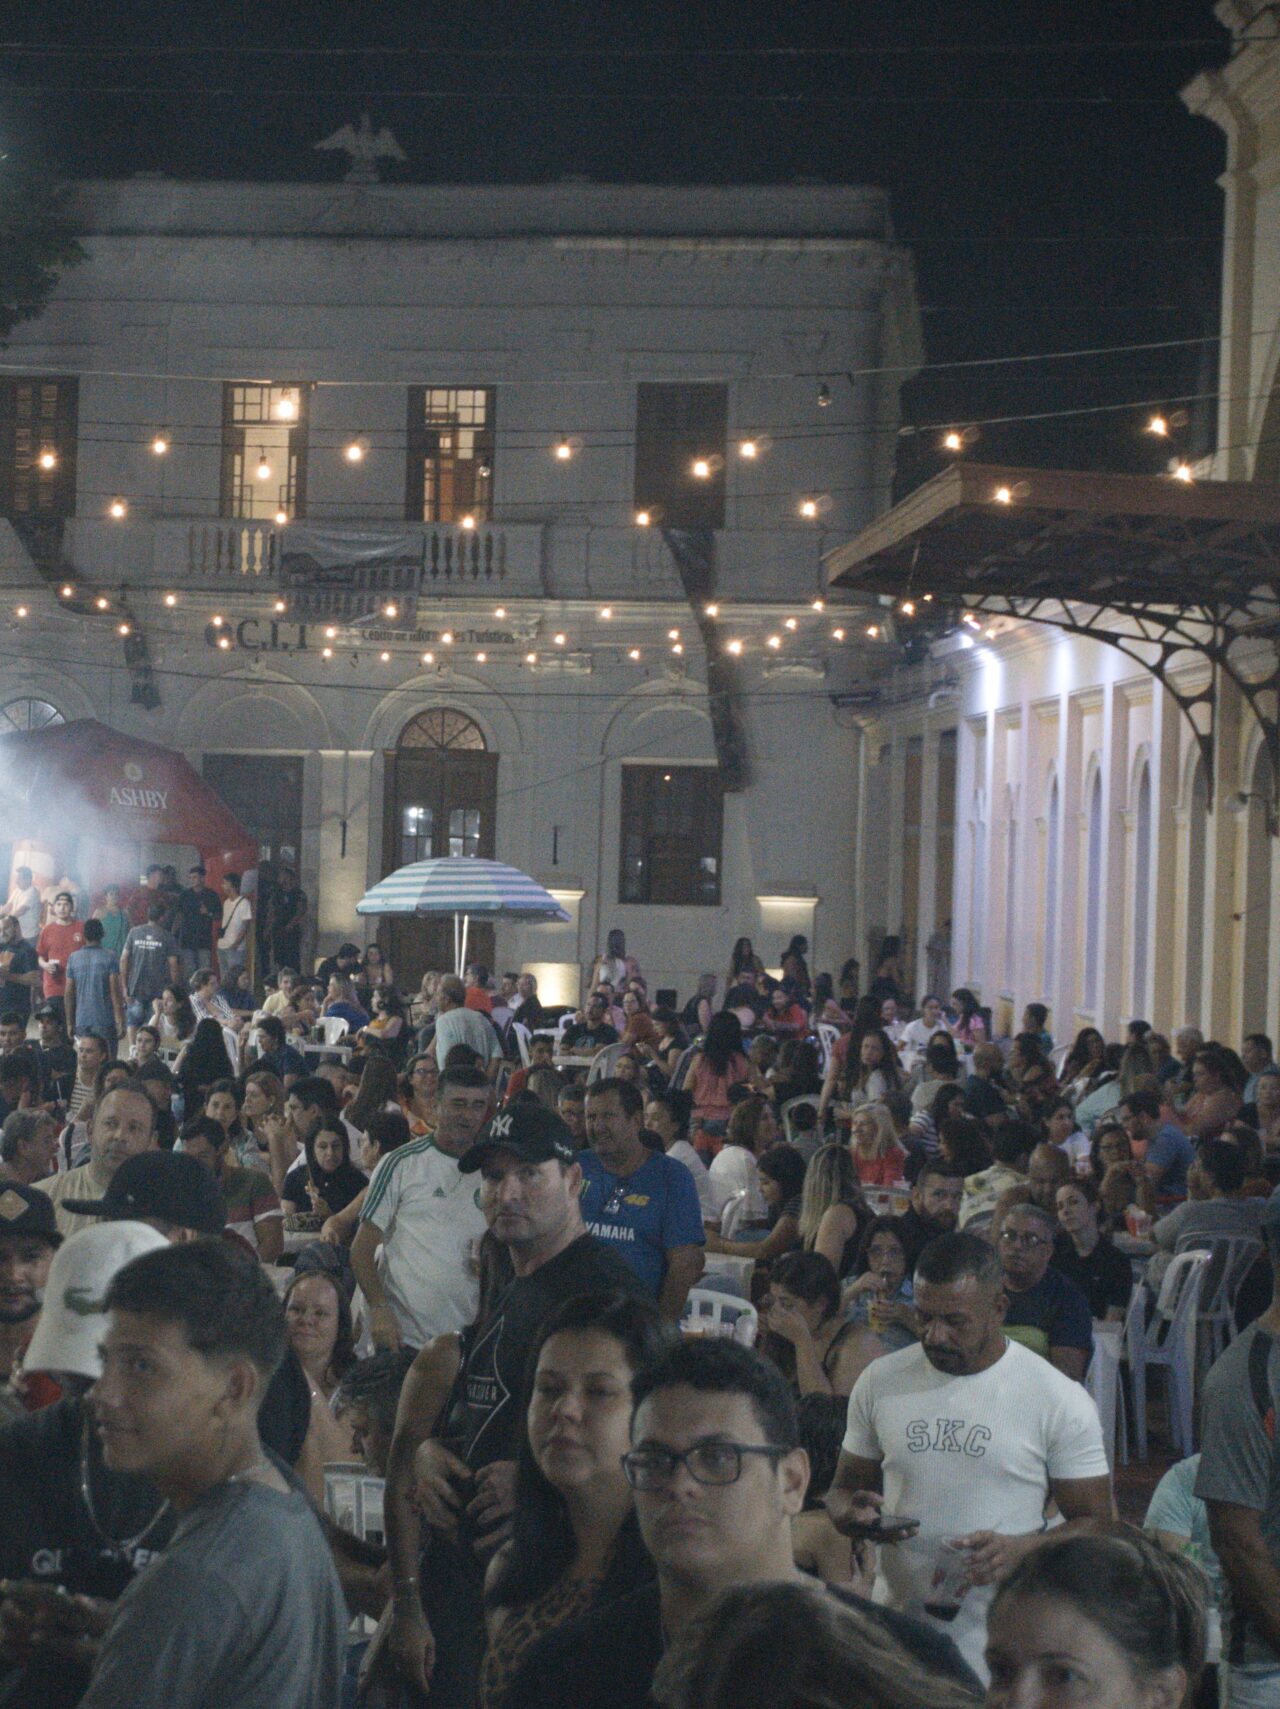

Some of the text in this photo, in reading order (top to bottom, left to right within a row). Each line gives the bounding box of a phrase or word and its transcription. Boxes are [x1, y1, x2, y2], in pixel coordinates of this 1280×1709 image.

[109, 787, 168, 810] ASHBY
[585, 1221, 636, 1242] YAMAHA
[906, 1418, 992, 1458] SKC
